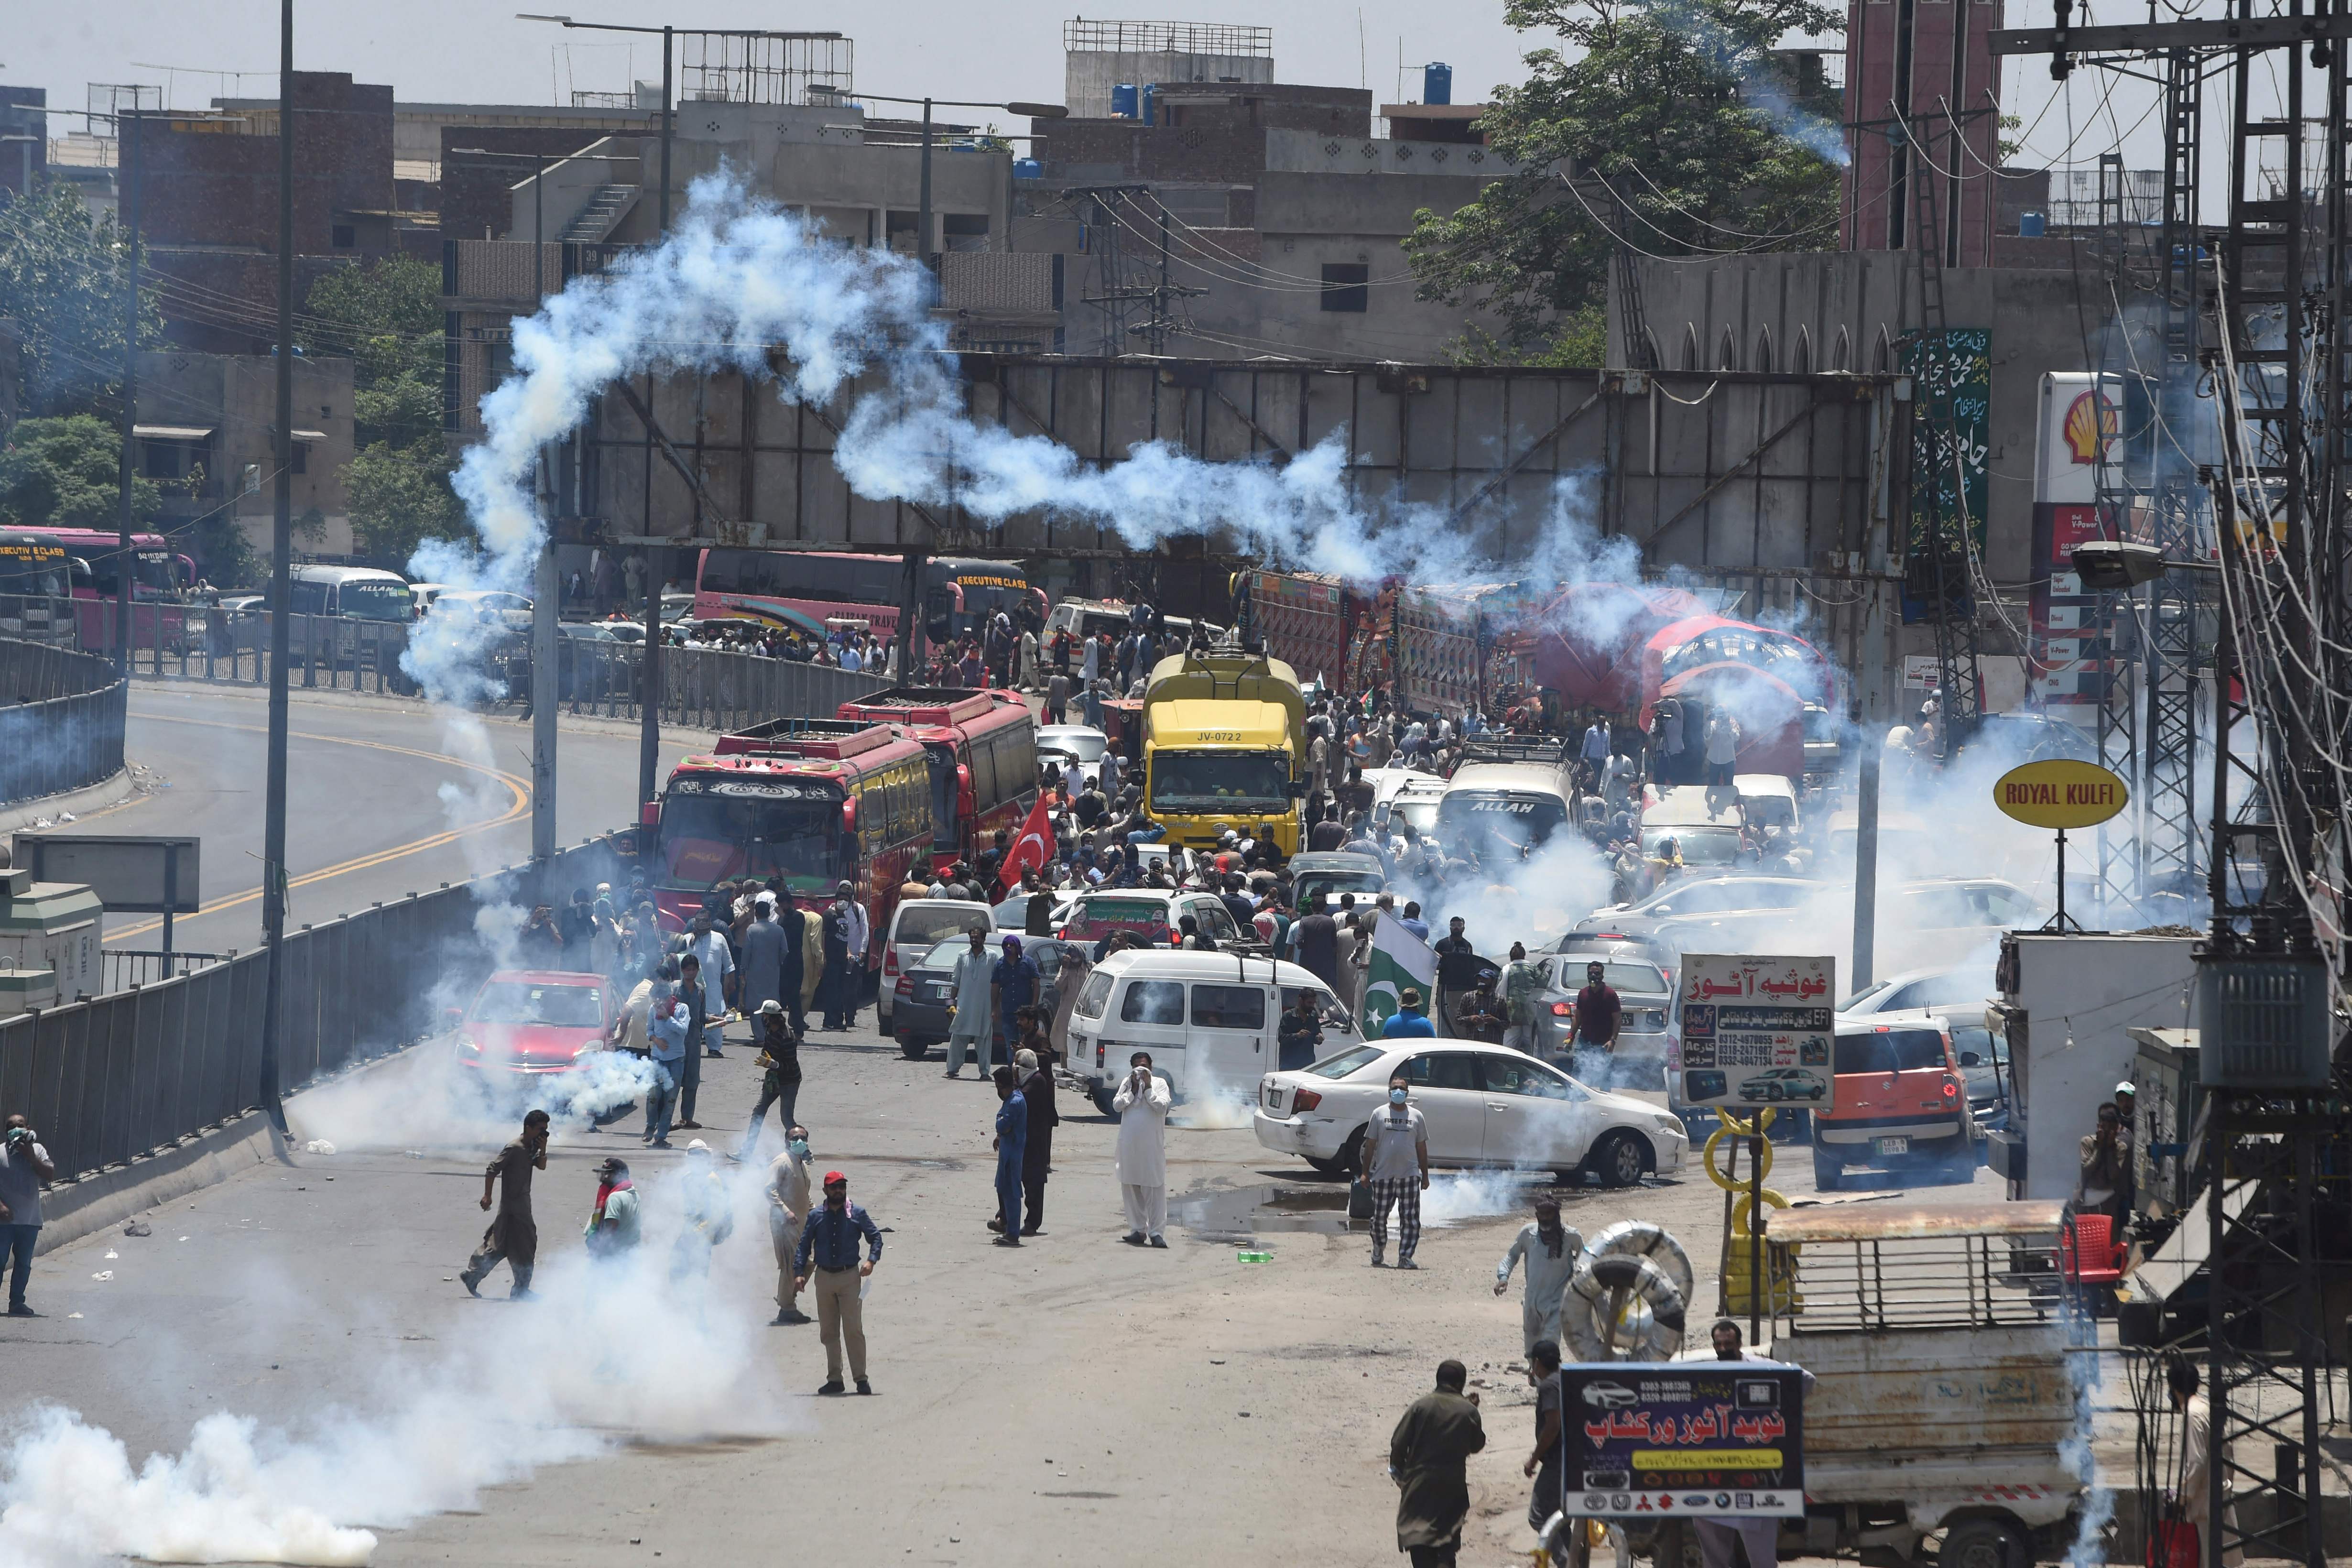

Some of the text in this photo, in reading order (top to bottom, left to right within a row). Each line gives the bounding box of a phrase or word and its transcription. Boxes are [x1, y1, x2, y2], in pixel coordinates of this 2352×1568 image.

[587, 250, 597, 261] 39
[40, 547, 64, 556] CLASS
[957, 576, 1002, 586] EXECUTIVE
[1004, 578, 1027, 589] CLASS
[870, 614, 899, 628] TRAVE
[1198, 732, 1241, 741] JV-0722
[2006, 784, 2113, 805] ROYAL KULFI
[1470, 802, 1535, 813] ALLAH
[1685, 968, 1827, 1002] غوثیہ آٹوز
[1814, 1009, 1829, 1025] EFI
[1585, 1404, 1786, 1449] نوید آٹوز ورکشاپ
